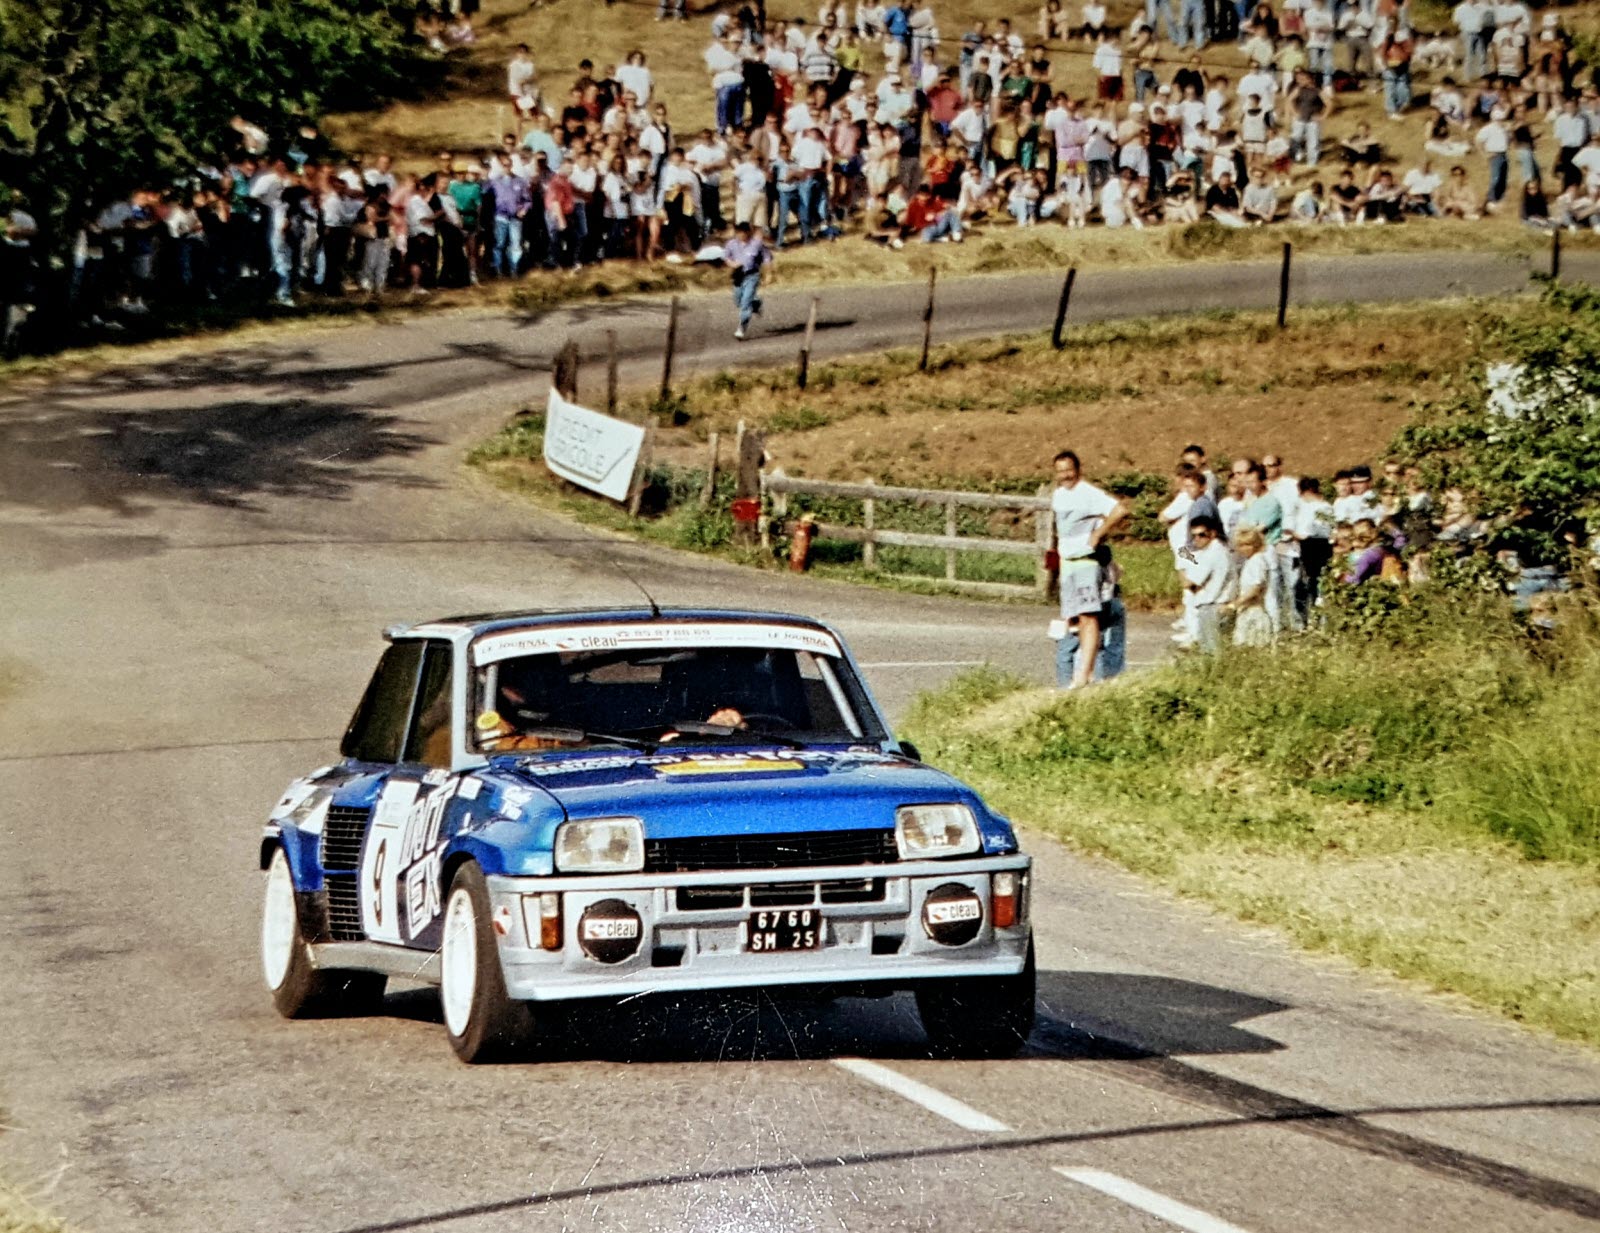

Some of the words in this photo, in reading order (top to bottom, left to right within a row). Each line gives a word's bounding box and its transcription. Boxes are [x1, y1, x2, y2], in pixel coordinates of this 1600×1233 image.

[498, 640, 551, 650] JOURNAL
[581, 636, 618, 648] cleau
[757, 910, 811, 929] 6760
[949, 904, 977, 919] cleau
[606, 920, 636, 937] cleau
[752, 932, 776, 950] SM
[792, 930, 814, 948] 25
